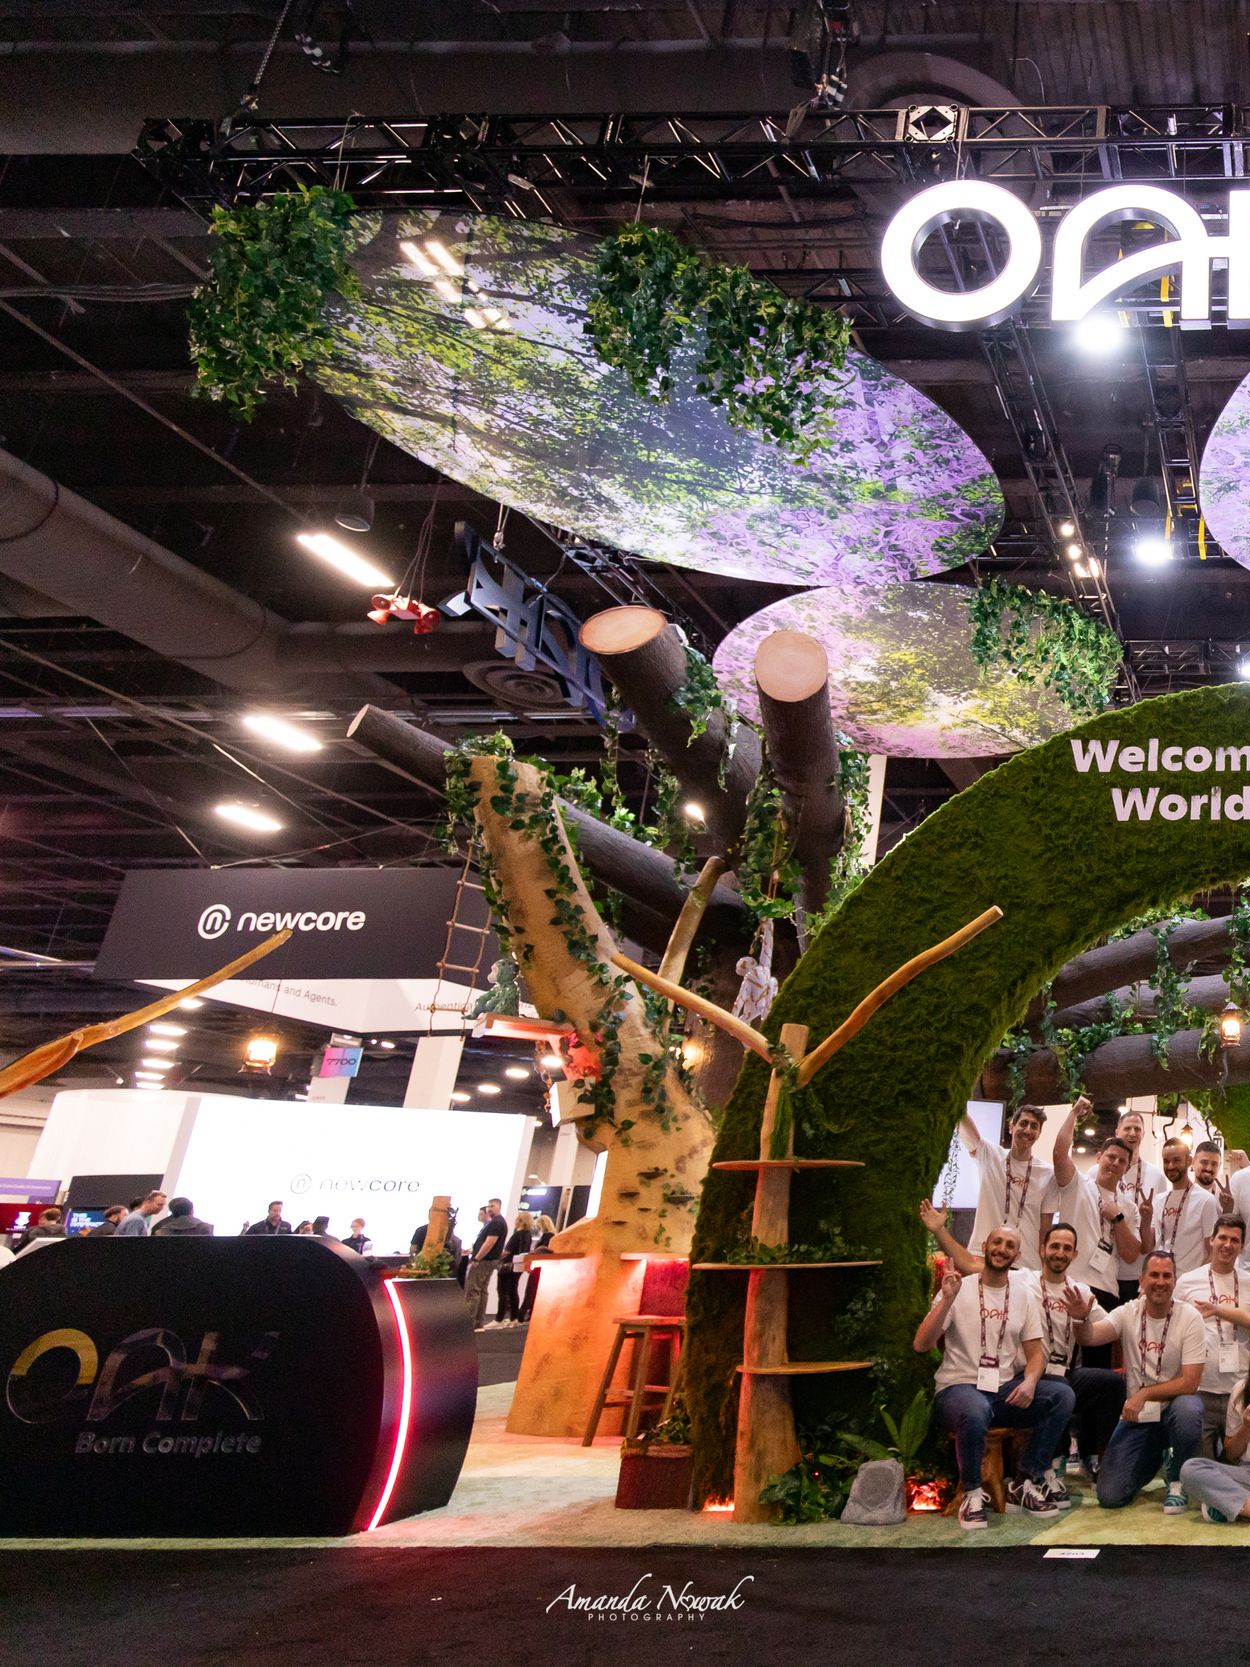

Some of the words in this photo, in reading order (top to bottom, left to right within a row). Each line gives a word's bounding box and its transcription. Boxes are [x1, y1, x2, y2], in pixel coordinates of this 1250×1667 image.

[237, 911, 366, 932] newcore
[284, 985, 301, 997] and
[75, 1431, 136, 1454] Born
[143, 1430, 262, 1458] Complete
